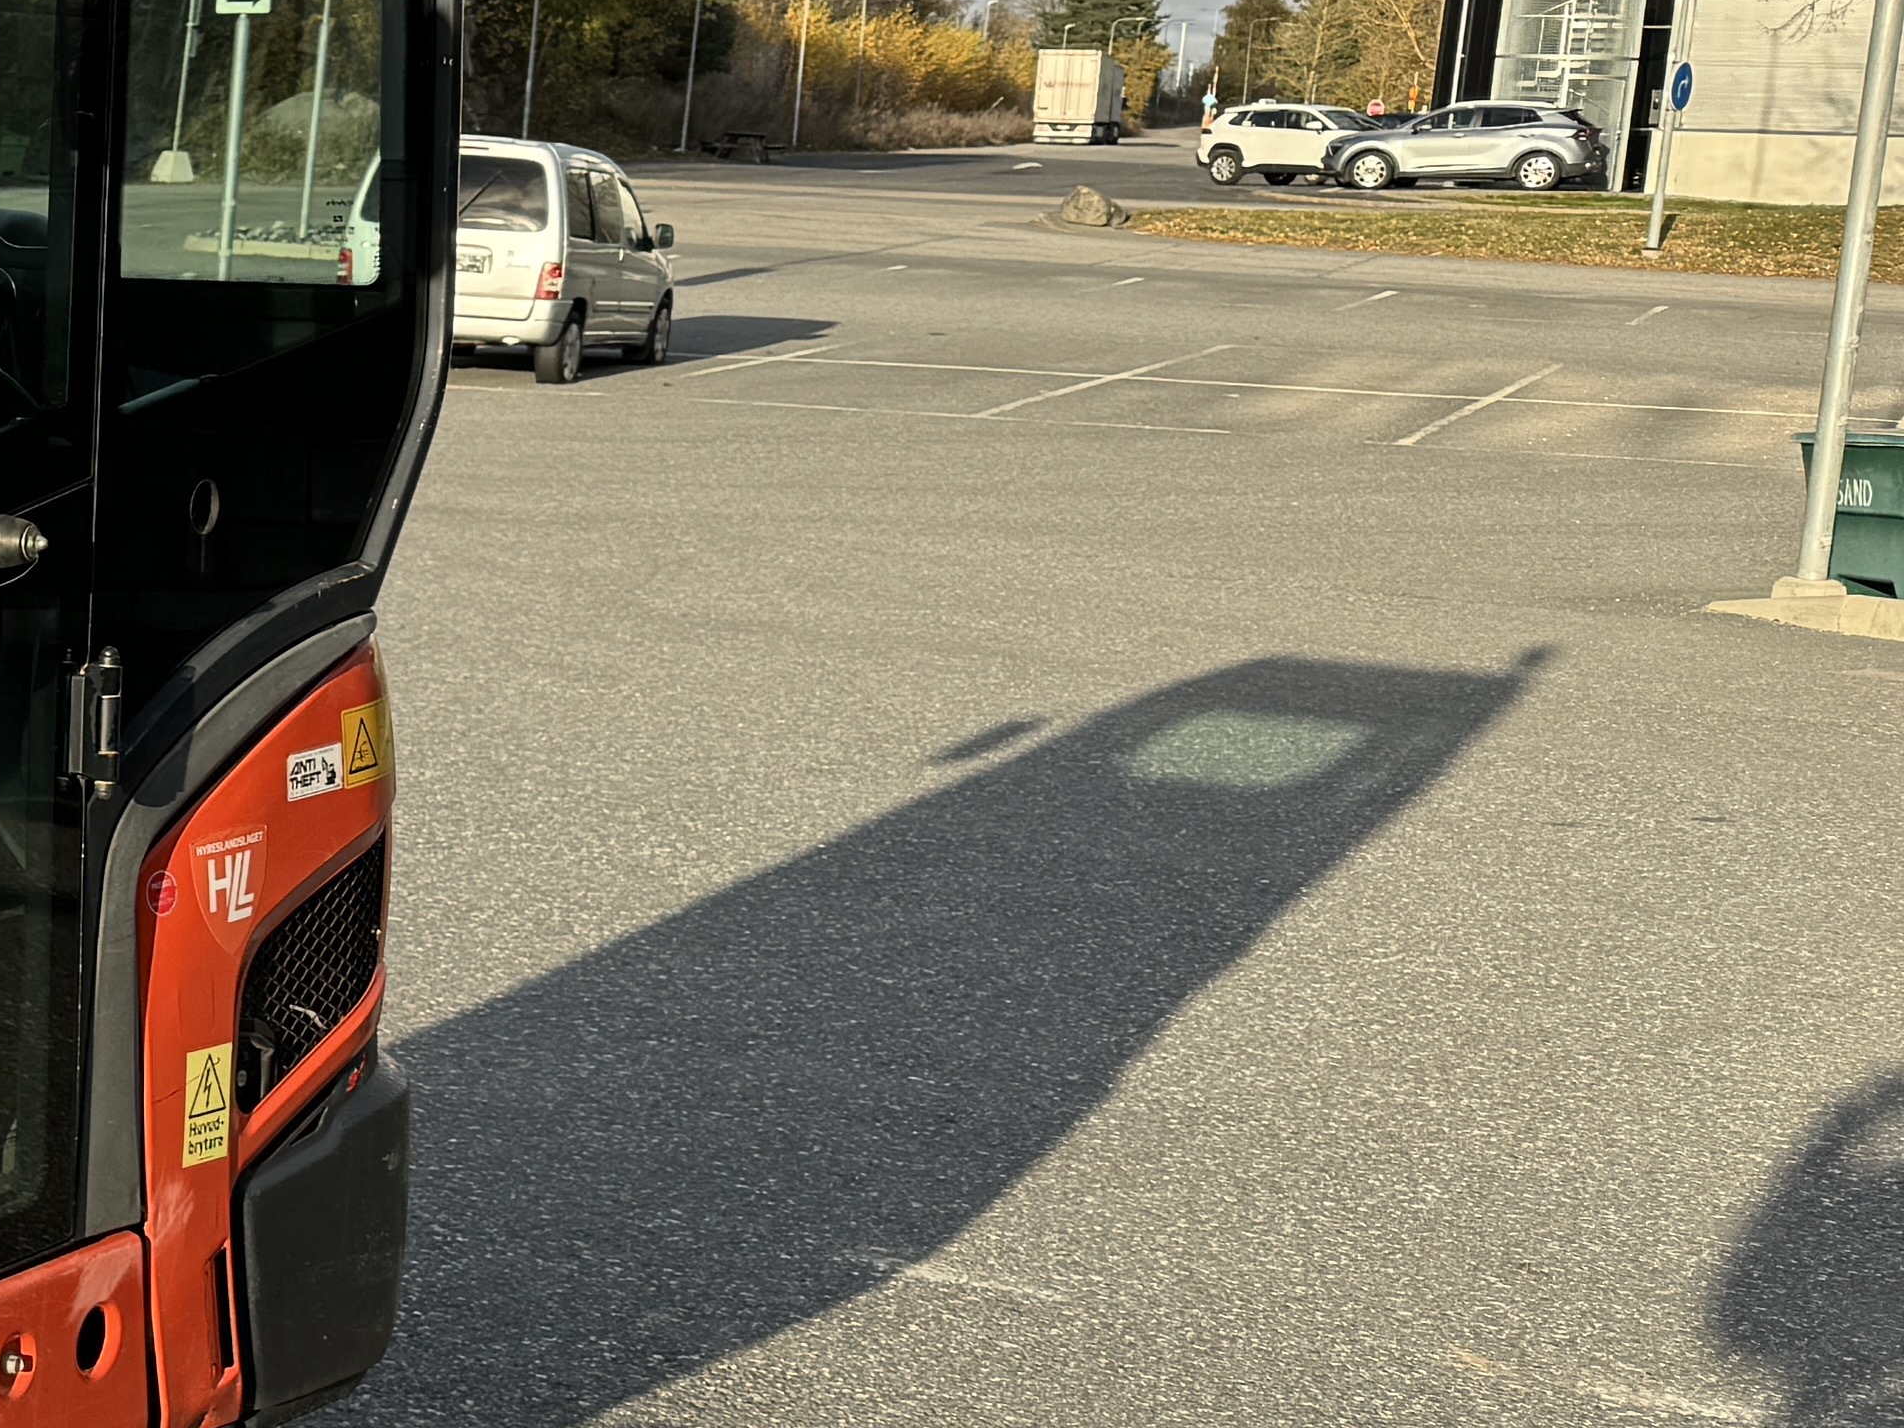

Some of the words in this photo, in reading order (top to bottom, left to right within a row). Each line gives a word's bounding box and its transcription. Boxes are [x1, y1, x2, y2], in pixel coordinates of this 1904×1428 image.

[290, 758, 316, 776] ANTI
[289, 771, 322, 789] THEFT
[207, 849, 254, 923] HLL
